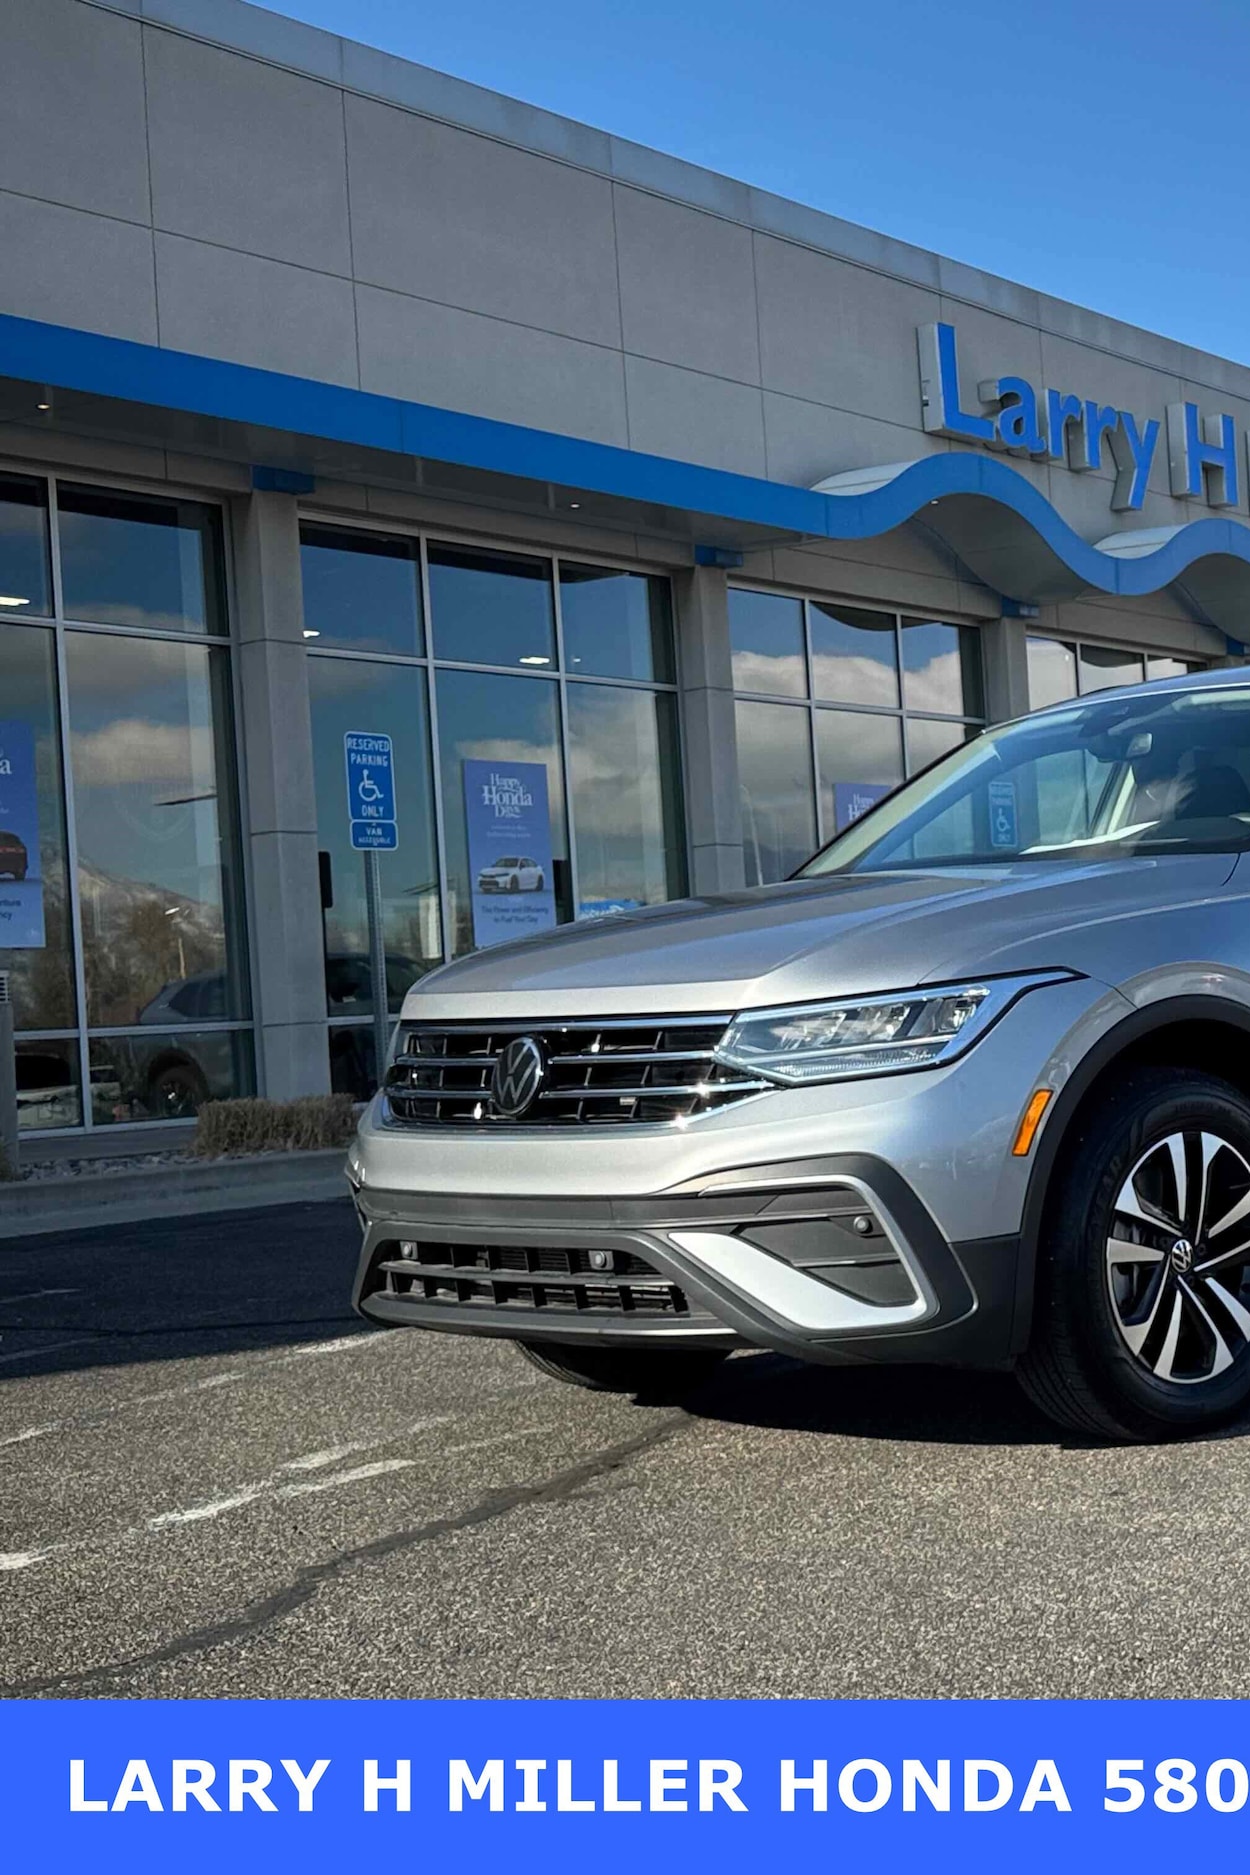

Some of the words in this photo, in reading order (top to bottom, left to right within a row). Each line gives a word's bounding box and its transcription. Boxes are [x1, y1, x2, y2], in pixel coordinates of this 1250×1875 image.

[918, 322, 1160, 510] Larry
[1167, 402, 1239, 507] H
[347, 737, 390, 752] RESERVED
[350, 753, 388, 767] PARKING
[482, 785, 533, 806] Honda
[361, 805, 384, 817] ONLY
[366, 827, 382, 836] VAN
